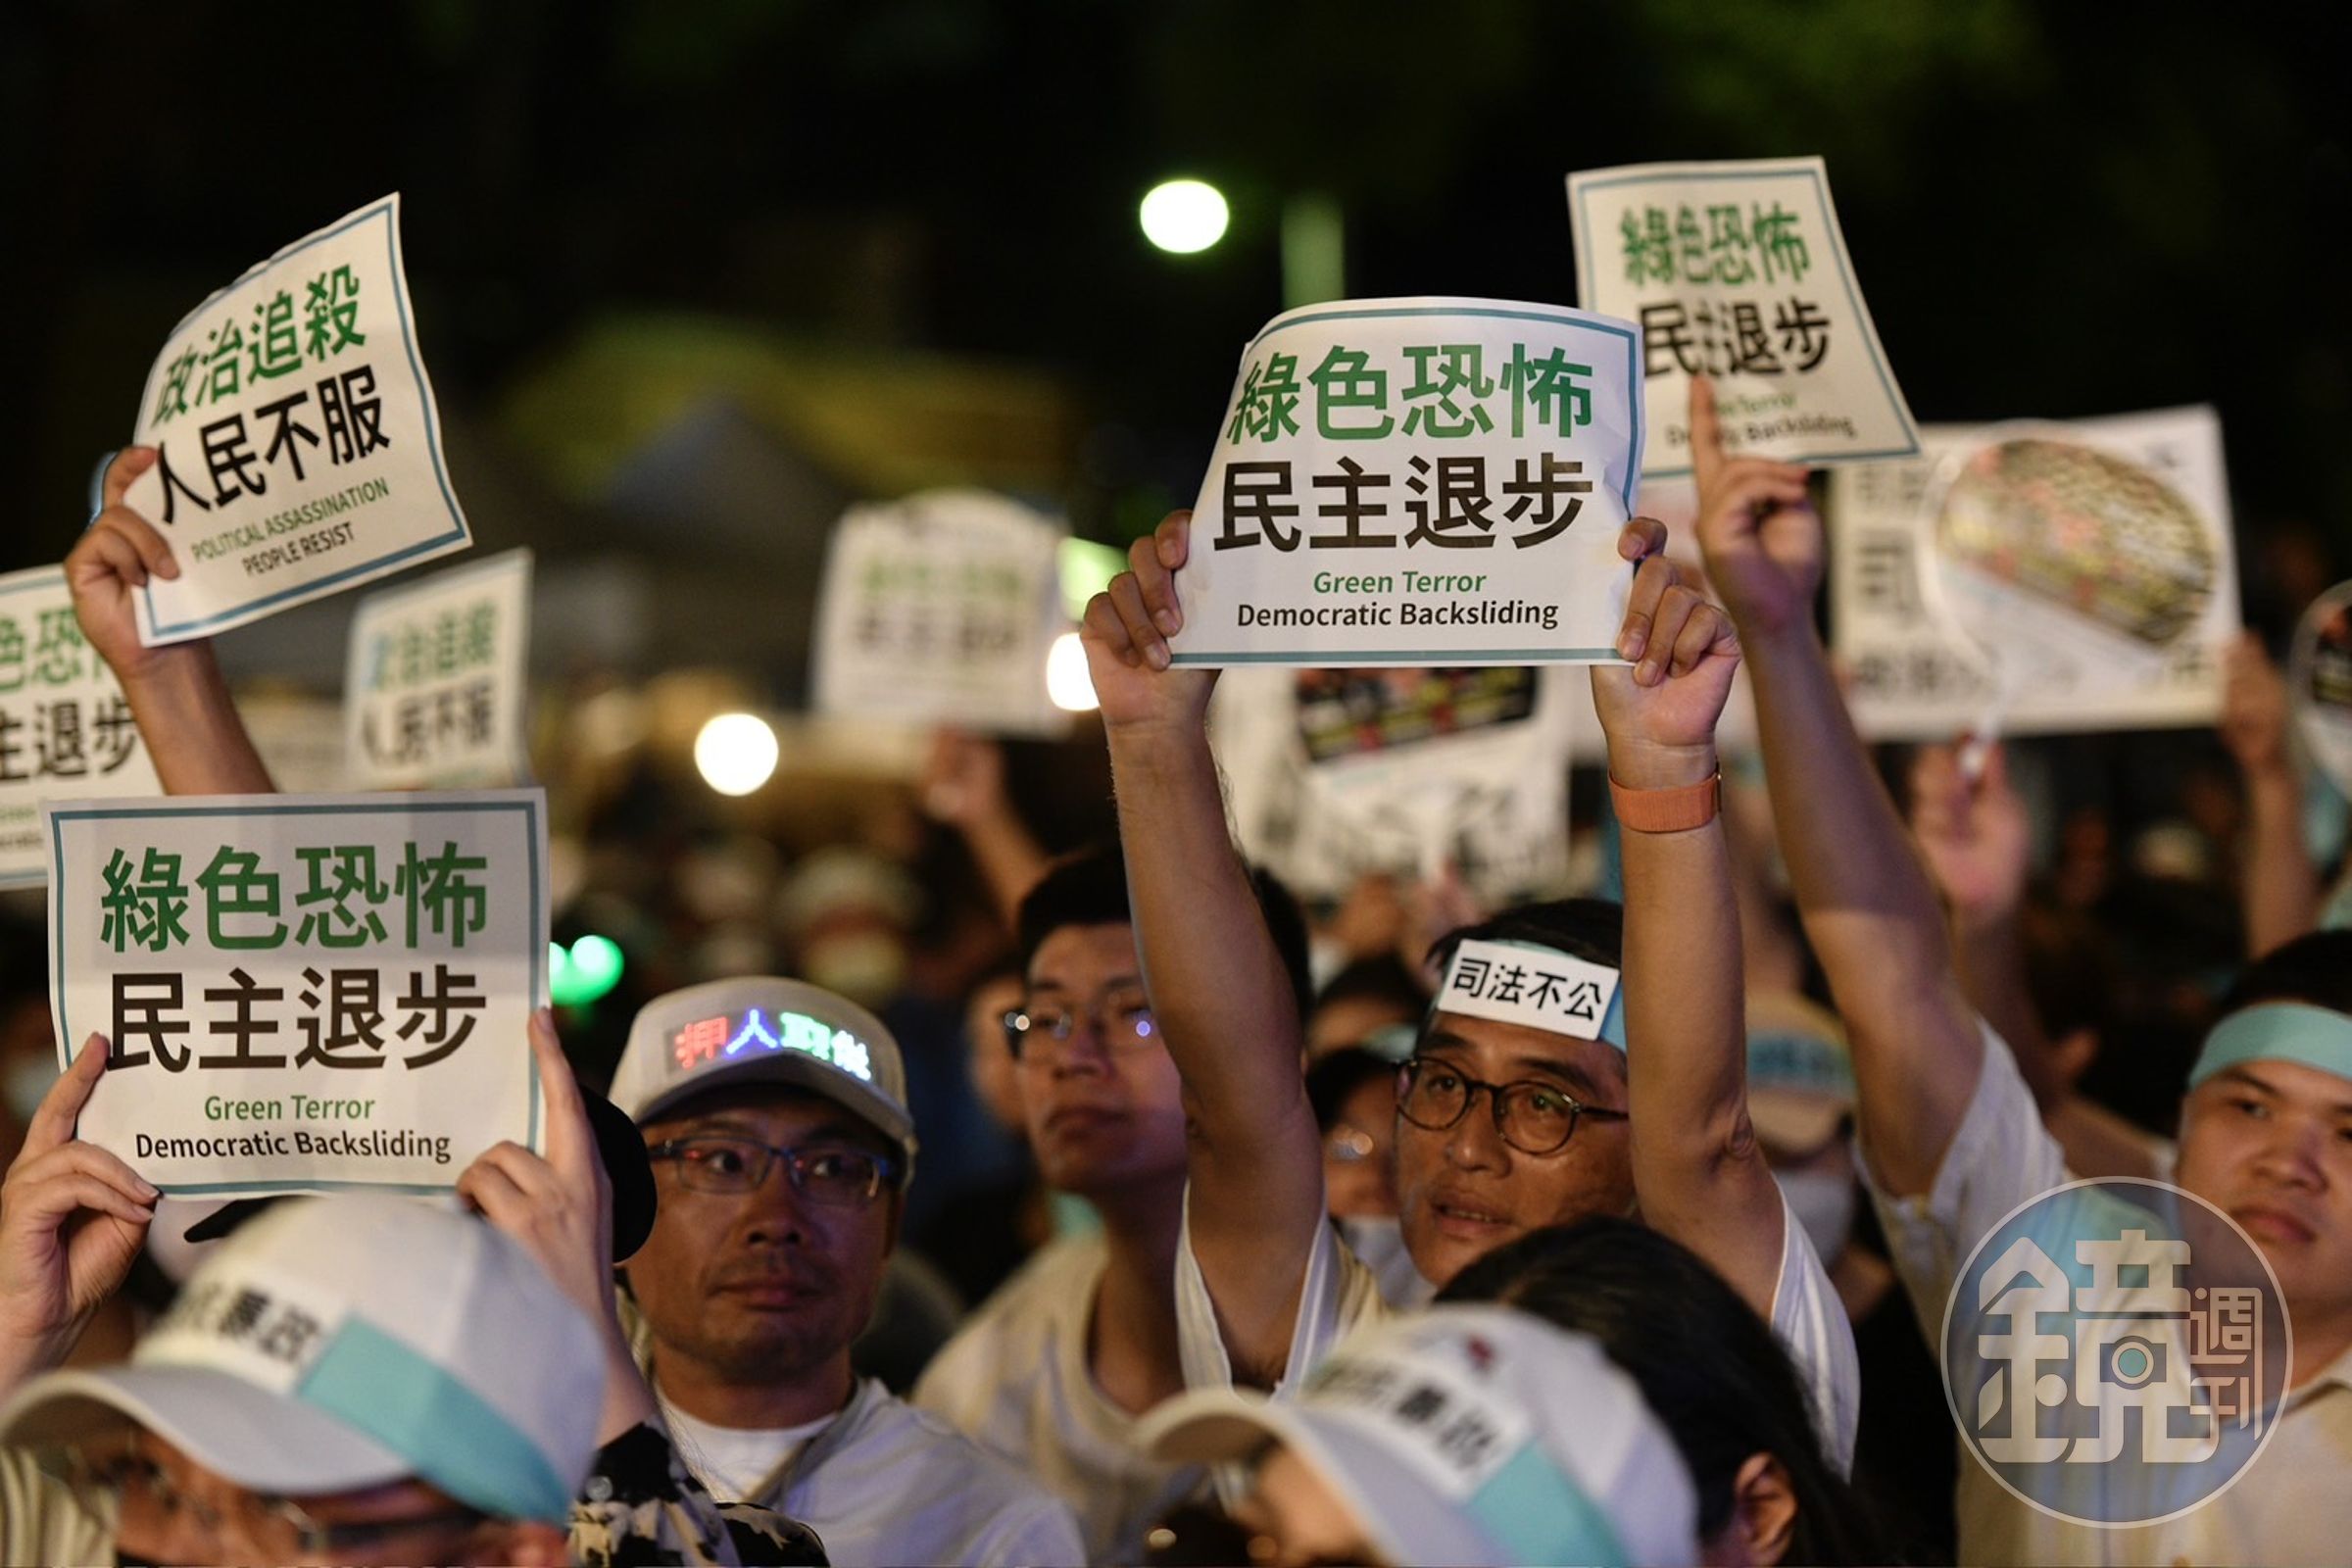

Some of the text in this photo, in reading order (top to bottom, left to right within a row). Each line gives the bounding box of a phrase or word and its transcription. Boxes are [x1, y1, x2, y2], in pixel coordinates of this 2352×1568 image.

[1621, 200, 1810, 285] 綠色恐怖
[150, 264, 367, 429] 政治追殺
[1226, 343, 1593, 445] 綠色恐怖
[158, 364, 391, 525] 人民不服
[191, 476, 390, 564] POLITICAL ASSASSINATION
[1213, 452, 1593, 553] 民主退步
[241, 521, 356, 576] PEOPLE RESIST
[1313, 570, 1488, 594] Green Terror
[1237, 599, 1559, 629] Democratic Backsliding
[100, 841, 489, 953] 綠色恐怖
[105, 963, 487, 1074] 民主退步
[1453, 956, 1602, 1022] 司法不公
[135, 1130, 451, 1163] Democratic Backsliding
[204, 1095, 375, 1120] Green Terror
